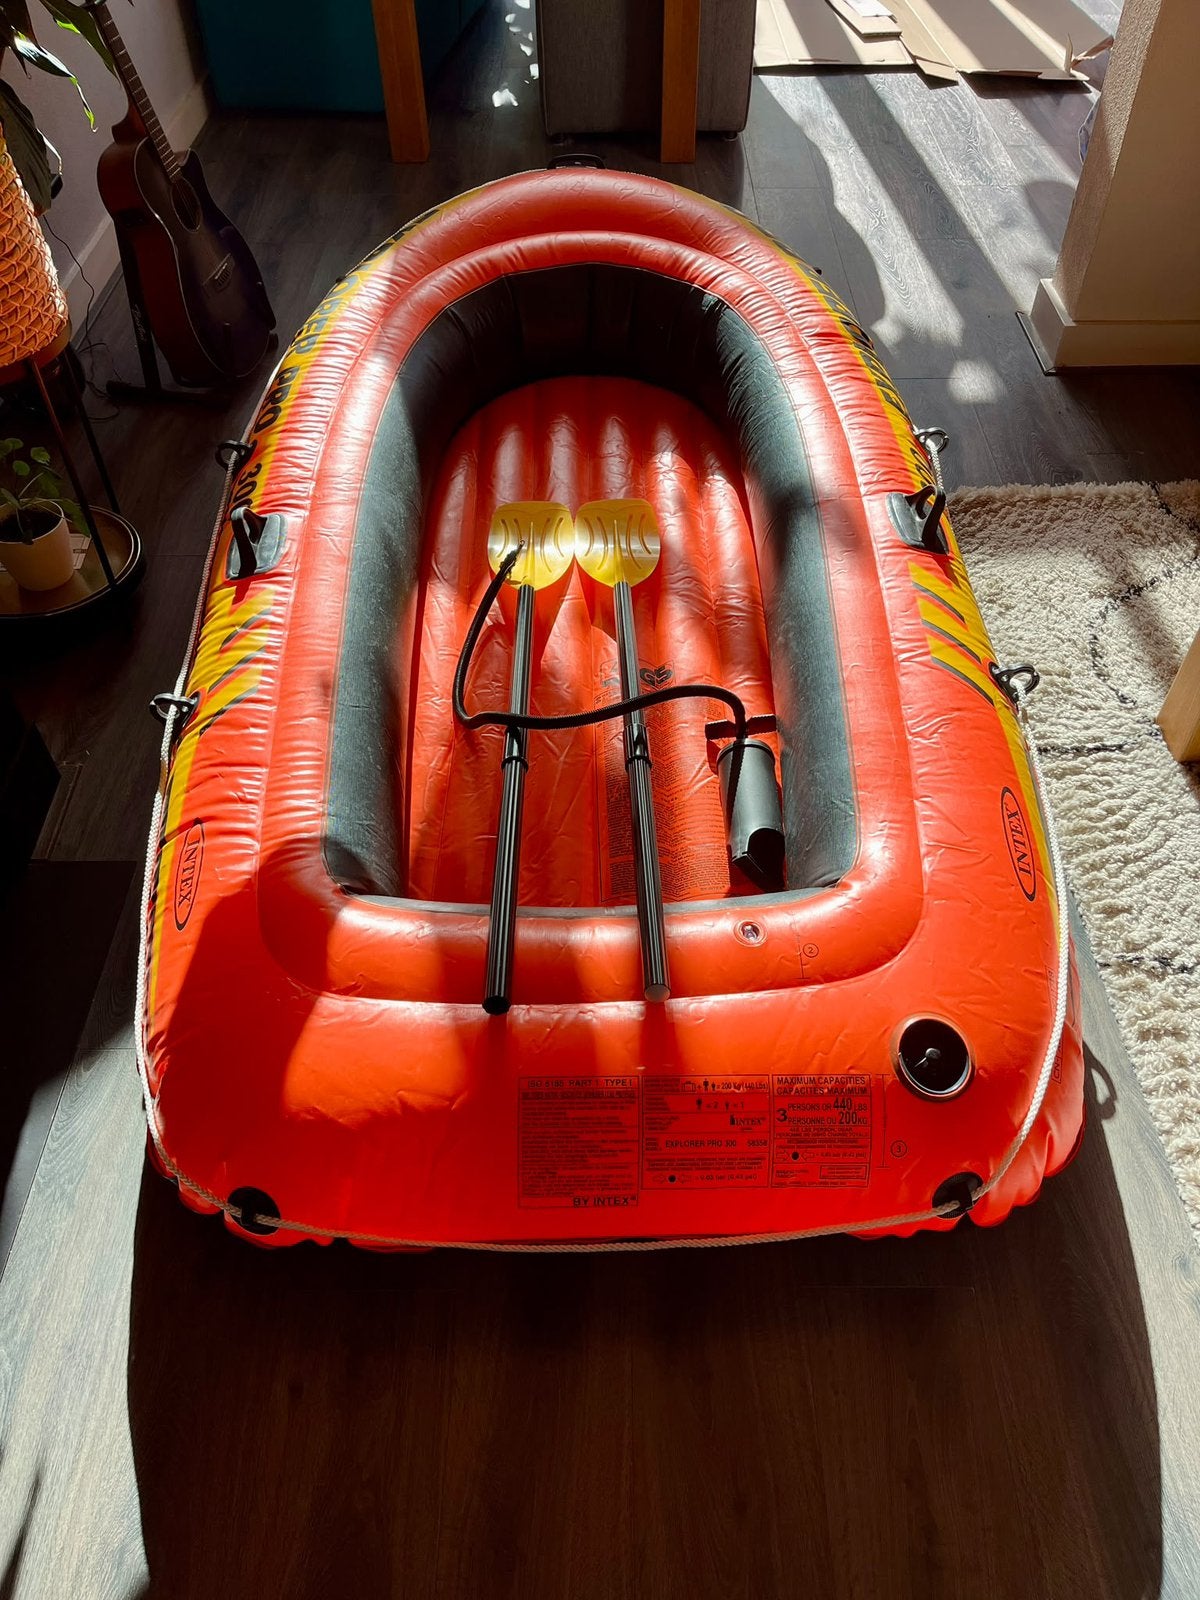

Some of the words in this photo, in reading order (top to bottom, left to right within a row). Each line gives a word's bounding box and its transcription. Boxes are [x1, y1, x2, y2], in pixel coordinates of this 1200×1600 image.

[253, 366, 300, 434] PRO
[1004, 802, 1032, 876] INTEX
[178, 838, 201, 908] INTEX
[604, 1078, 627, 1087] TYPE
[777, 1076, 816, 1085] MAXIMUM
[819, 1076, 865, 1085] CAPACITIES
[777, 1087, 824, 1096] CAPACITES
[827, 1086, 867, 1095] MAXIMUM
[788, 1103, 820, 1111] PERSONS
[822, 1103, 832, 1111] OR
[833, 1097, 852, 1110] 440
[854, 1103, 868, 1111] LBS
[776, 1108, 788, 1122] 3
[788, 1116, 825, 1125] PERSONNE
[827, 1116, 837, 1125] OU
[839, 1111, 857, 1124] 200
[857, 1116, 867, 1125] KG
[665, 1139, 704, 1148] EXPLORER
[707, 1139, 722, 1147] PRO
[573, 1196, 588, 1208] BY
